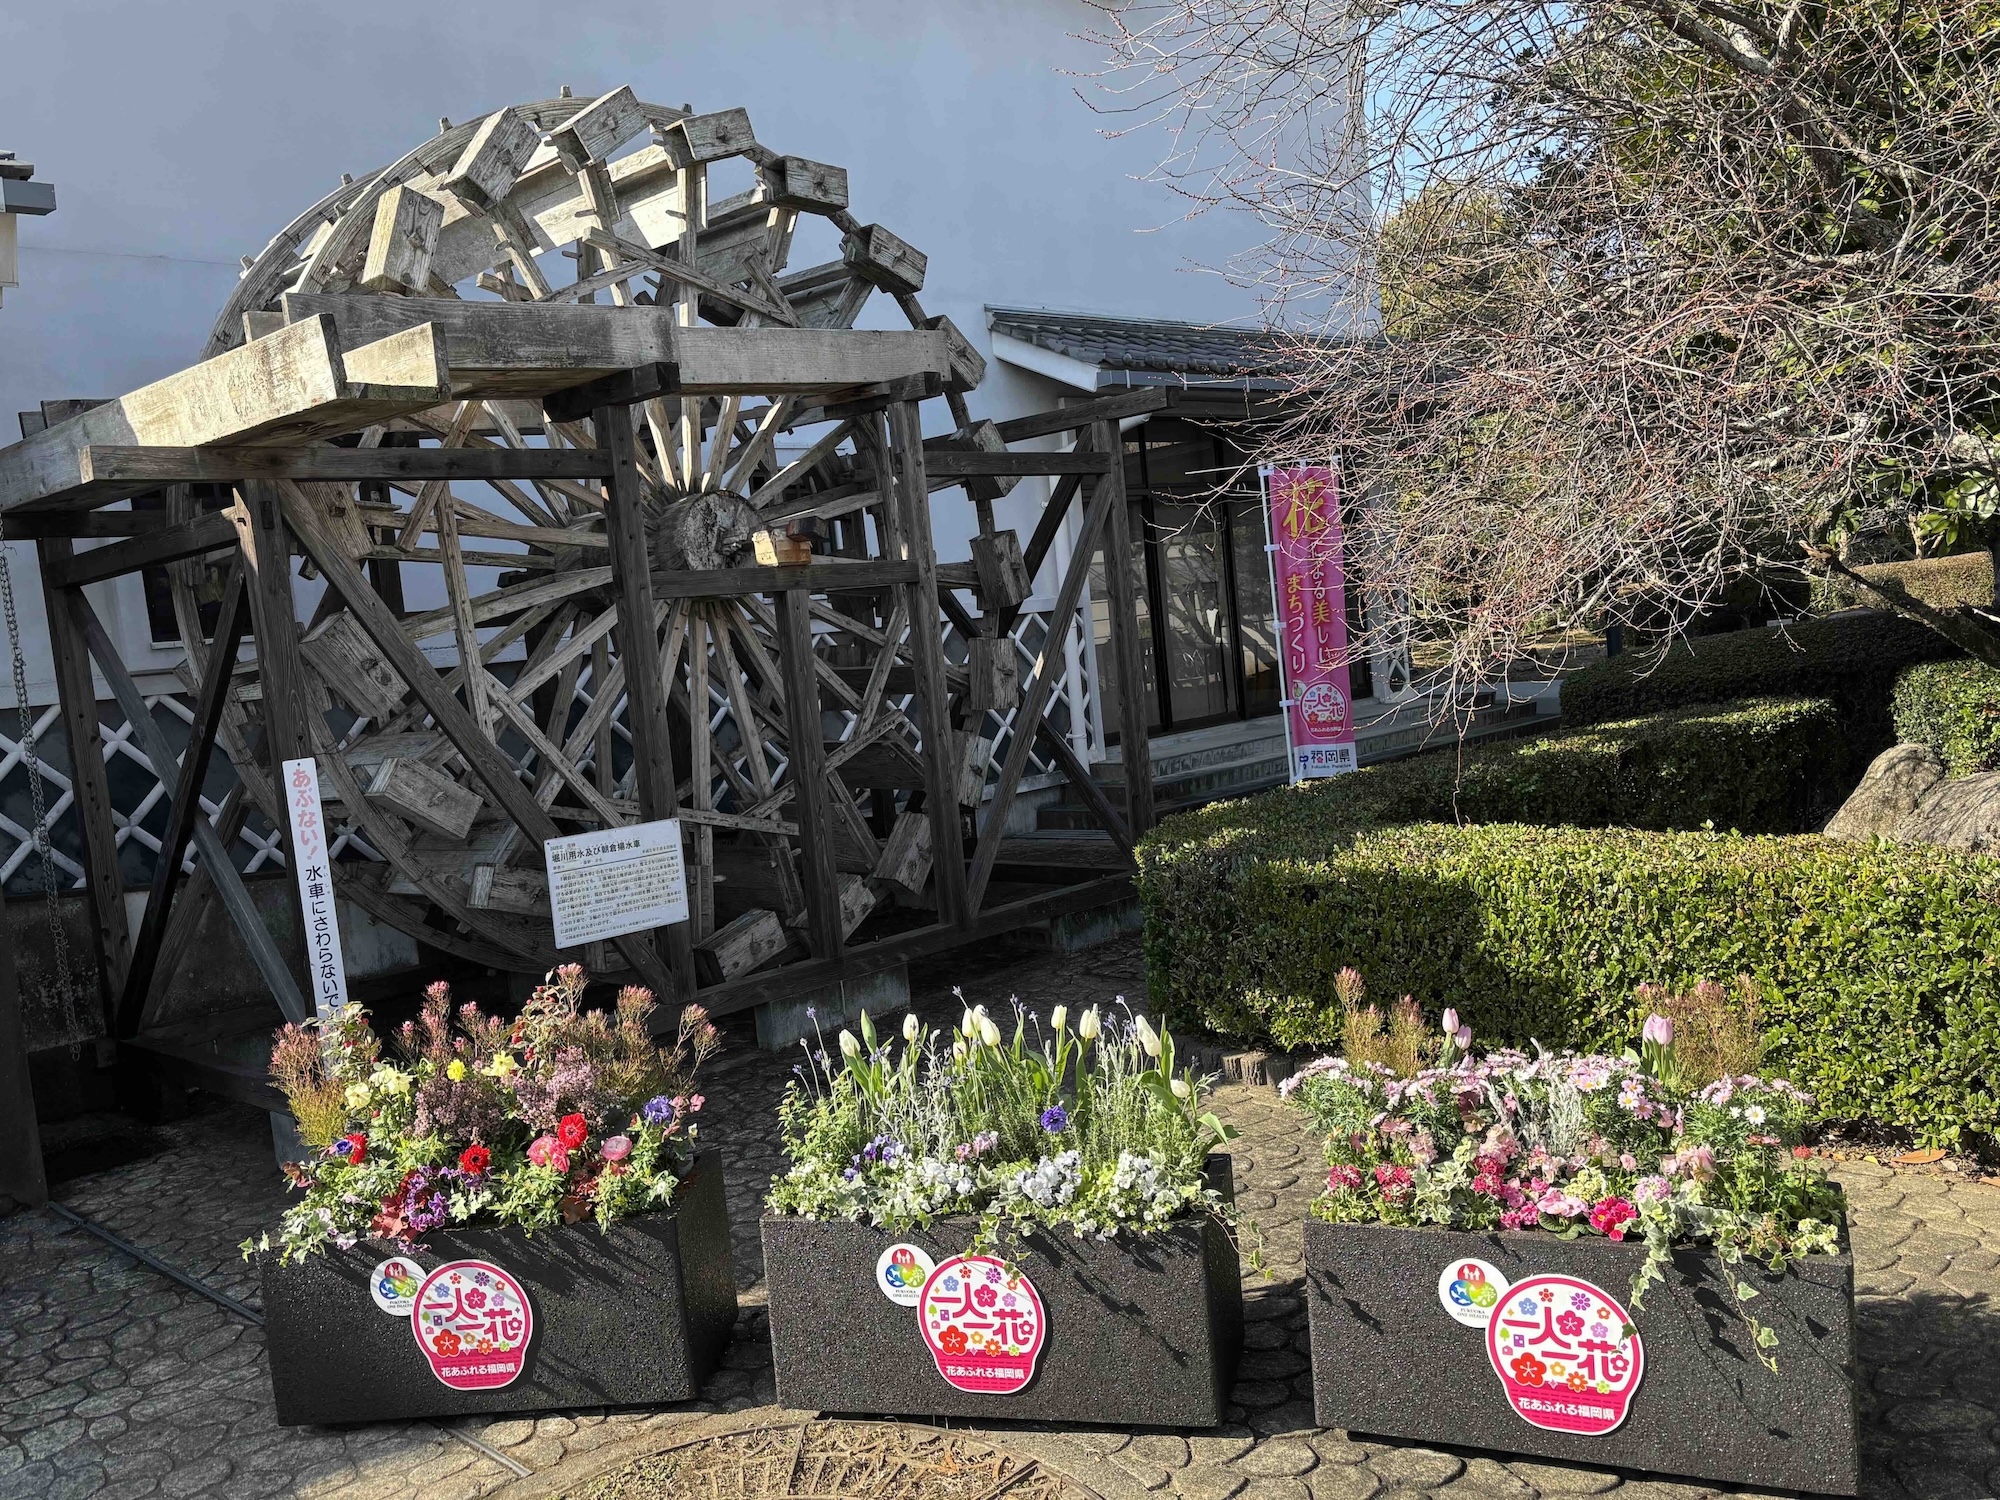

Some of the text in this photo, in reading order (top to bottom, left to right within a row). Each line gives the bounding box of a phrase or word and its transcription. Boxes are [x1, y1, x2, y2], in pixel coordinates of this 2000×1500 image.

[1287, 574, 1305, 674] まちづくり
[1311, 749, 1350, 763] 福岡県
[306, 865, 339, 1007] 水車にさわらないで
[423, 1288, 520, 1342] 一人一花
[930, 1283, 1032, 1345] 一人一花
[441, 1363, 516, 1377] 花あふれる福岡県
[1502, 1307, 1626, 1382] 一人一花
[946, 1365, 1025, 1379] 花あふれる福岡県
[1518, 1397, 1615, 1420] 花あふれる福岡県
